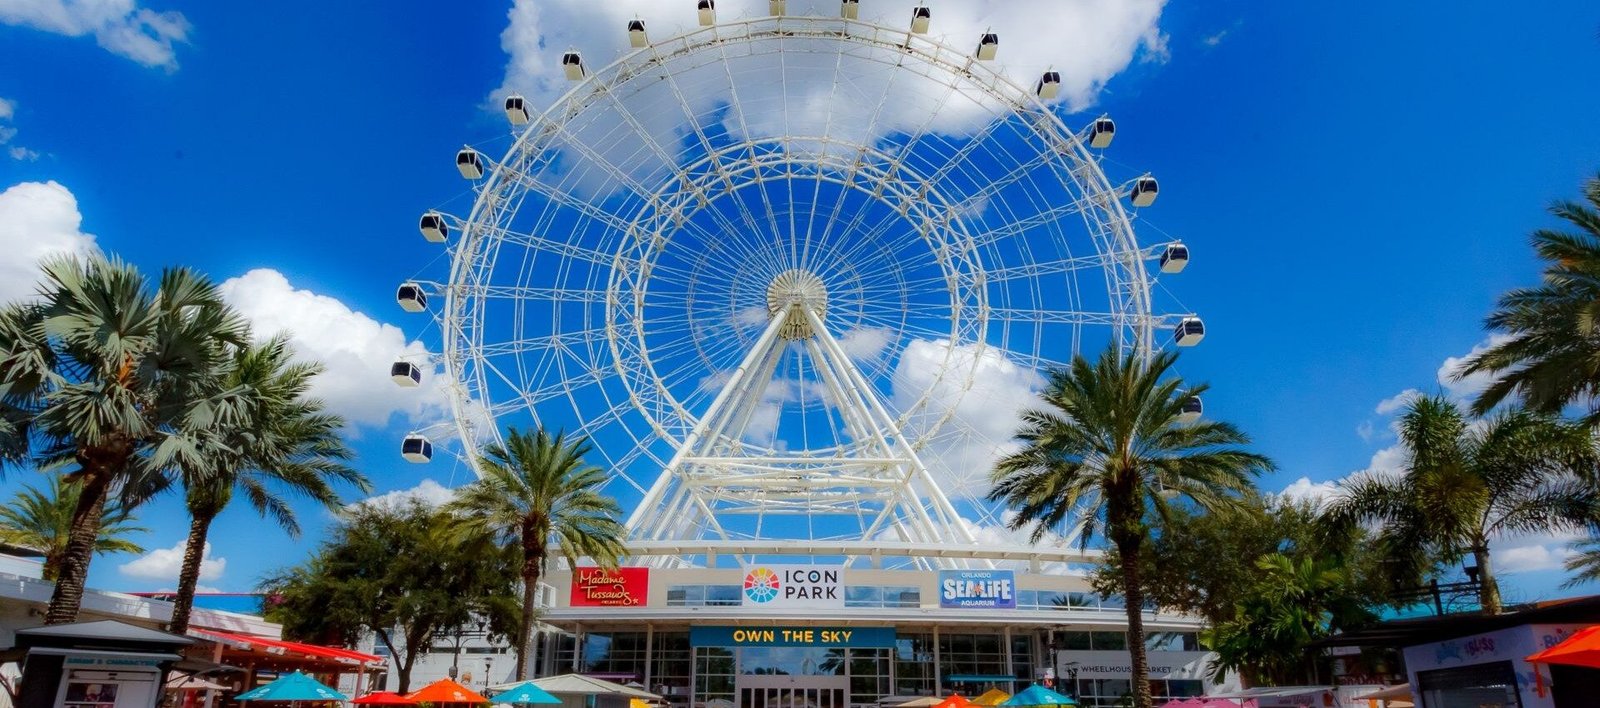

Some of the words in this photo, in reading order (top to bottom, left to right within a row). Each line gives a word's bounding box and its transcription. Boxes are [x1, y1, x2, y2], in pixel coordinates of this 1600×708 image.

[580, 569, 627, 585] Madame
[785, 570, 837, 583] ICON
[580, 584, 632, 605] Tussauds
[785, 586, 837, 599] PARK
[733, 630, 774, 642] OWN
[782, 631, 814, 642] THE
[821, 631, 852, 642] SKY
[1081, 665, 1132, 673] WHEELHOUS
